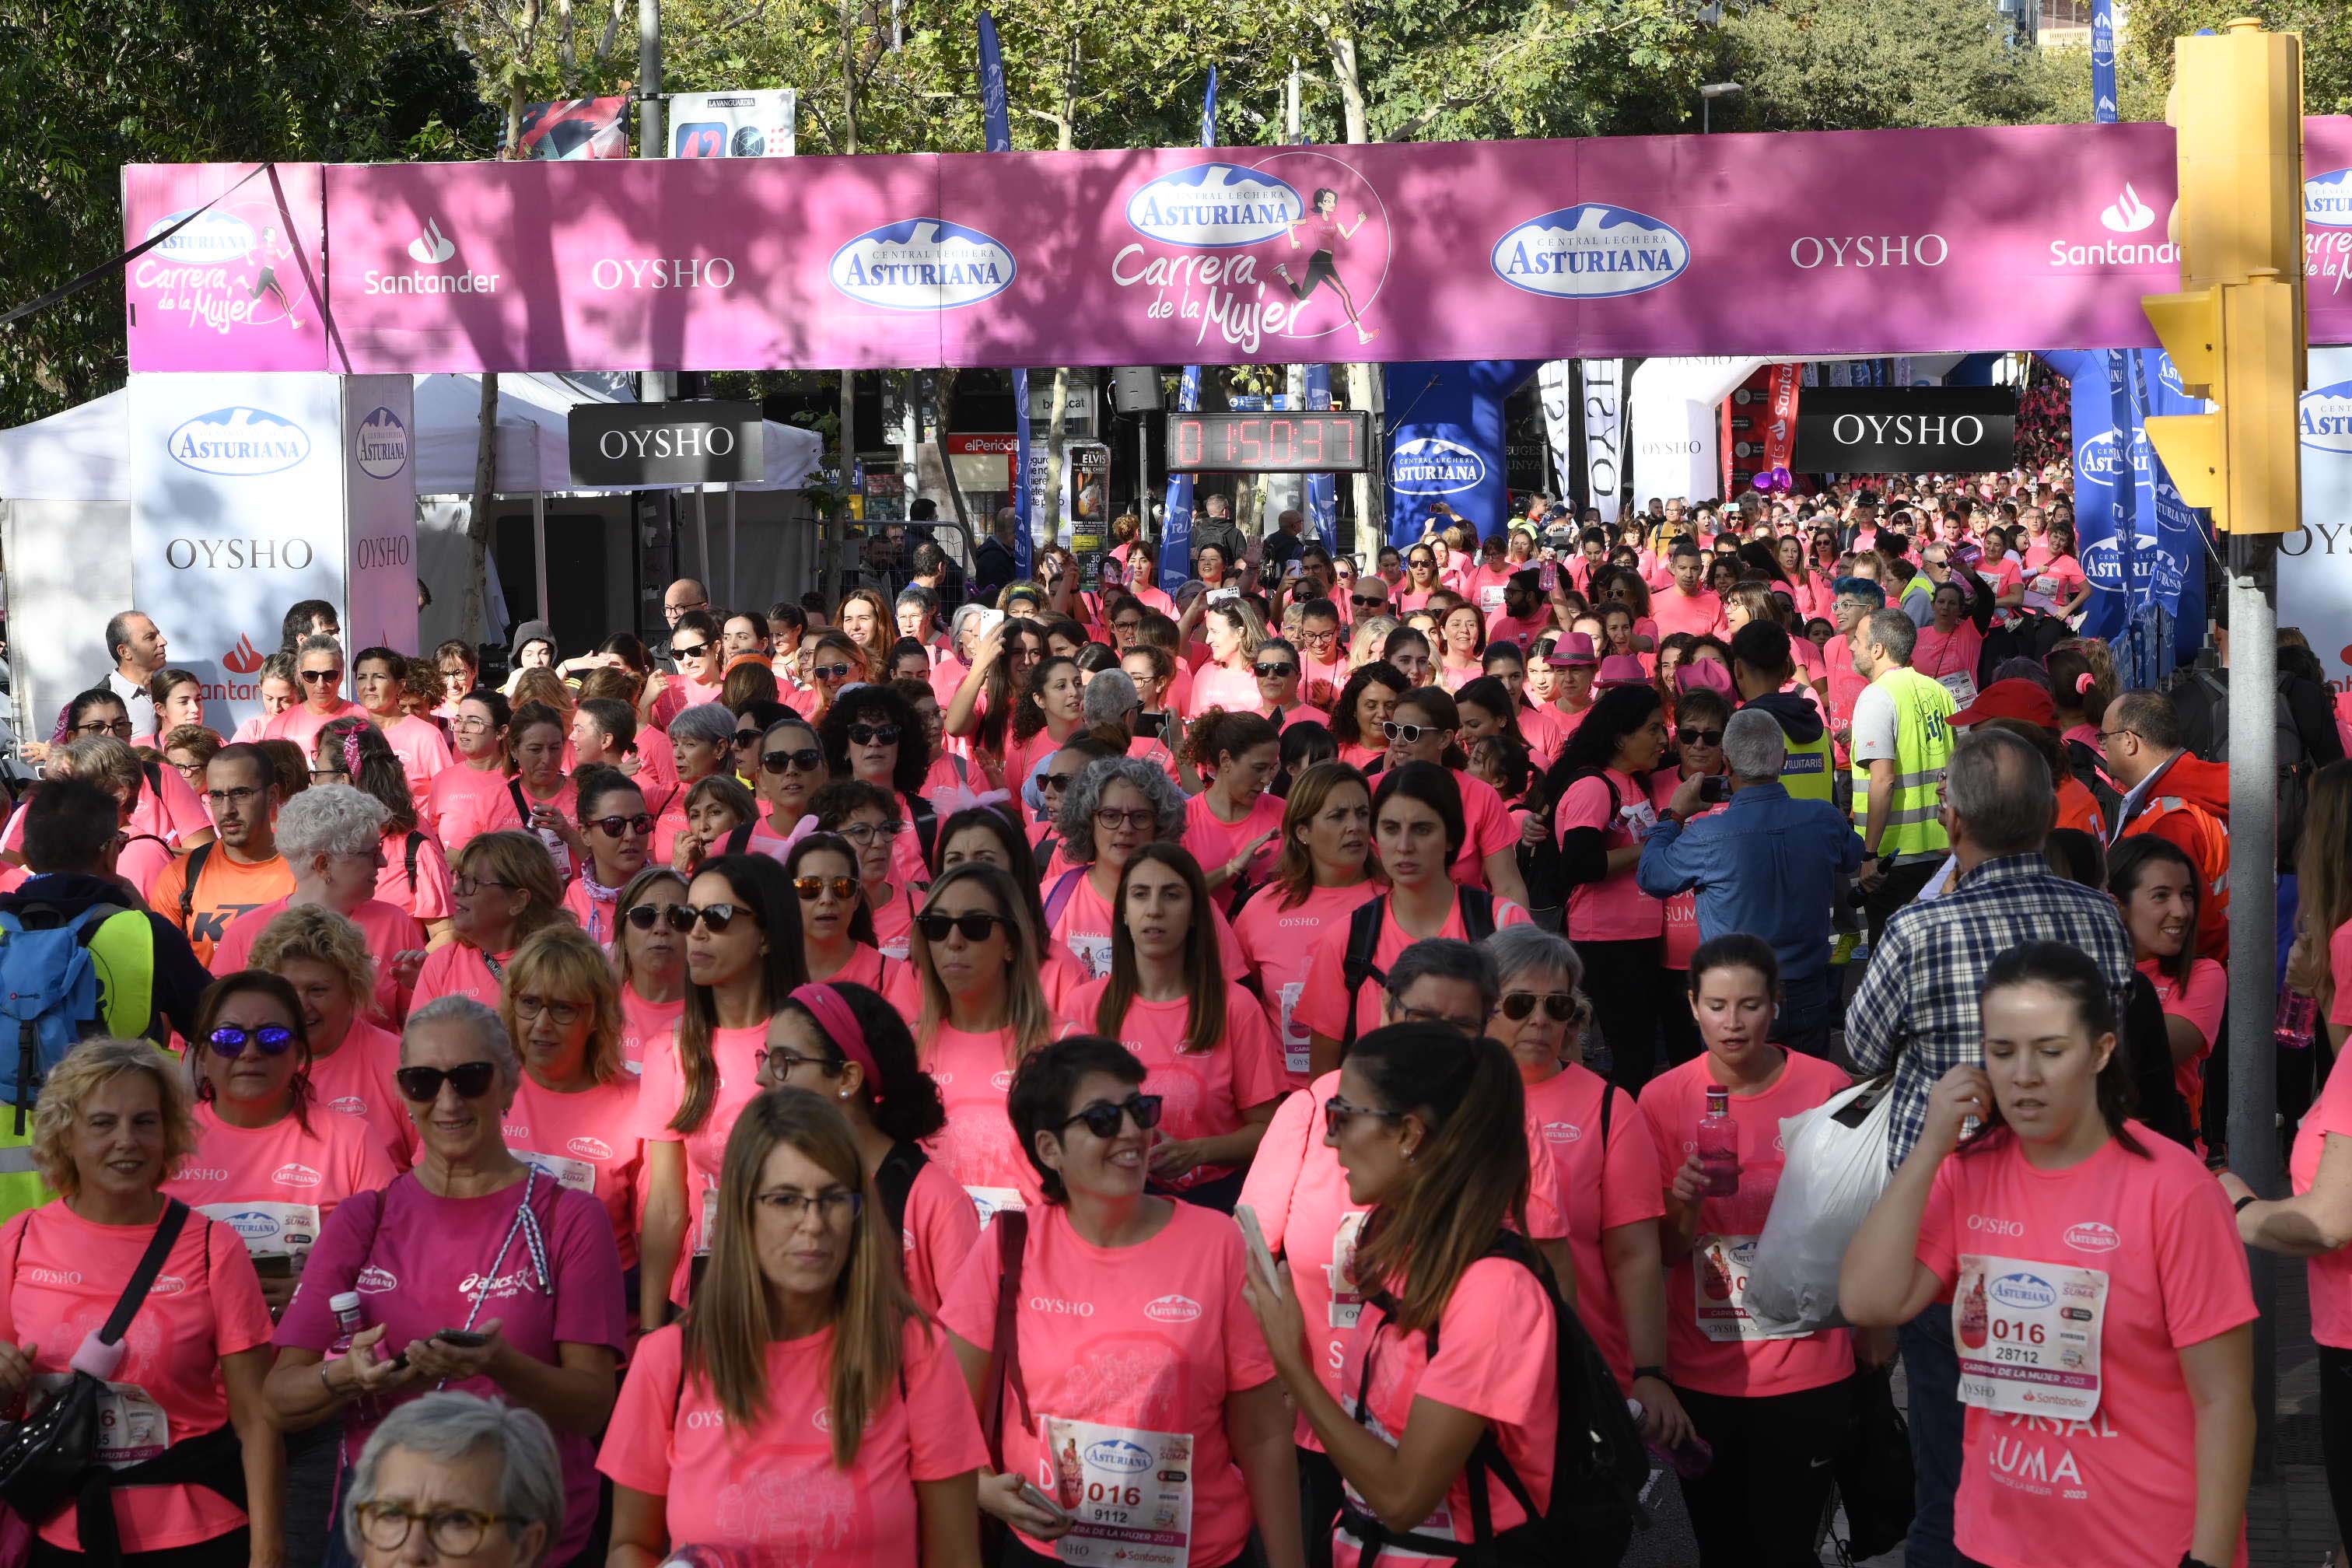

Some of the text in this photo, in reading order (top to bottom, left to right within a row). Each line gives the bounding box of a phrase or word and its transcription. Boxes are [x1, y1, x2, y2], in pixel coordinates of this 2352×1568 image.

[1141, 189, 1290, 227] ASTURIANA
[1229, 191, 1286, 200] LECHERA
[1537, 235, 1668, 247] CENTRAL LECHERA
[1790, 233, 1949, 268] OYSHO
[872, 249, 996, 259] CENTRAL LECHERA
[1112, 243, 1258, 287] Carrera
[1506, 240, 1675, 275] ASTURIANA
[135, 260, 226, 289] Carrera
[363, 269, 500, 295] Santander
[591, 257, 736, 290] OYSHO
[845, 253, 1002, 286] ASTURIANA
[158, 286, 262, 334] de la Mujer
[1147, 279, 1313, 355] de la Mujer
[1179, 420, 1354, 464] 01:50:37
[1833, 414, 1983, 446] OYSHO
[179, 432, 299, 459] ASTURIANA
[359, 434, 405, 462] ASTURIANA
[600, 426, 734, 460] OYSHO
[1082, 453, 1106, 464] ELVIS
[1391, 464, 1478, 484] ASTURIANA
[165, 537, 313, 569] OYSHO
[358, 534, 409, 569] OYSHO
[1090, 555, 1101, 563] 30
[1279, 917, 1320, 927] OYSHO
[284, 1219, 311, 1227] SUMA
[31, 1269, 82, 1285] OYSHO
[1996, 1283, 2051, 1303] ASTURIANA
[1030, 1297, 1094, 1318] OYSHO
[1992, 1319, 2046, 1344] 016
[1995, 1347, 2039, 1364] 28712
[1998, 1368, 2011, 1377] DE
[2013, 1370, 2026, 1379] LA
[2028, 1372, 2061, 1383] MUJER
[2036, 1392, 2087, 1409] Santander
[1090, 1448, 1148, 1468] ASTURIANA
[1088, 1482, 1142, 1507] 016
[1094, 1508, 1129, 1524] 9112
[1092, 1528, 1104, 1536] DE
[1107, 1529, 1118, 1538] LA
[1120, 1531, 1152, 1542] MUJER
[1128, 1552, 1176, 1565] Santander
